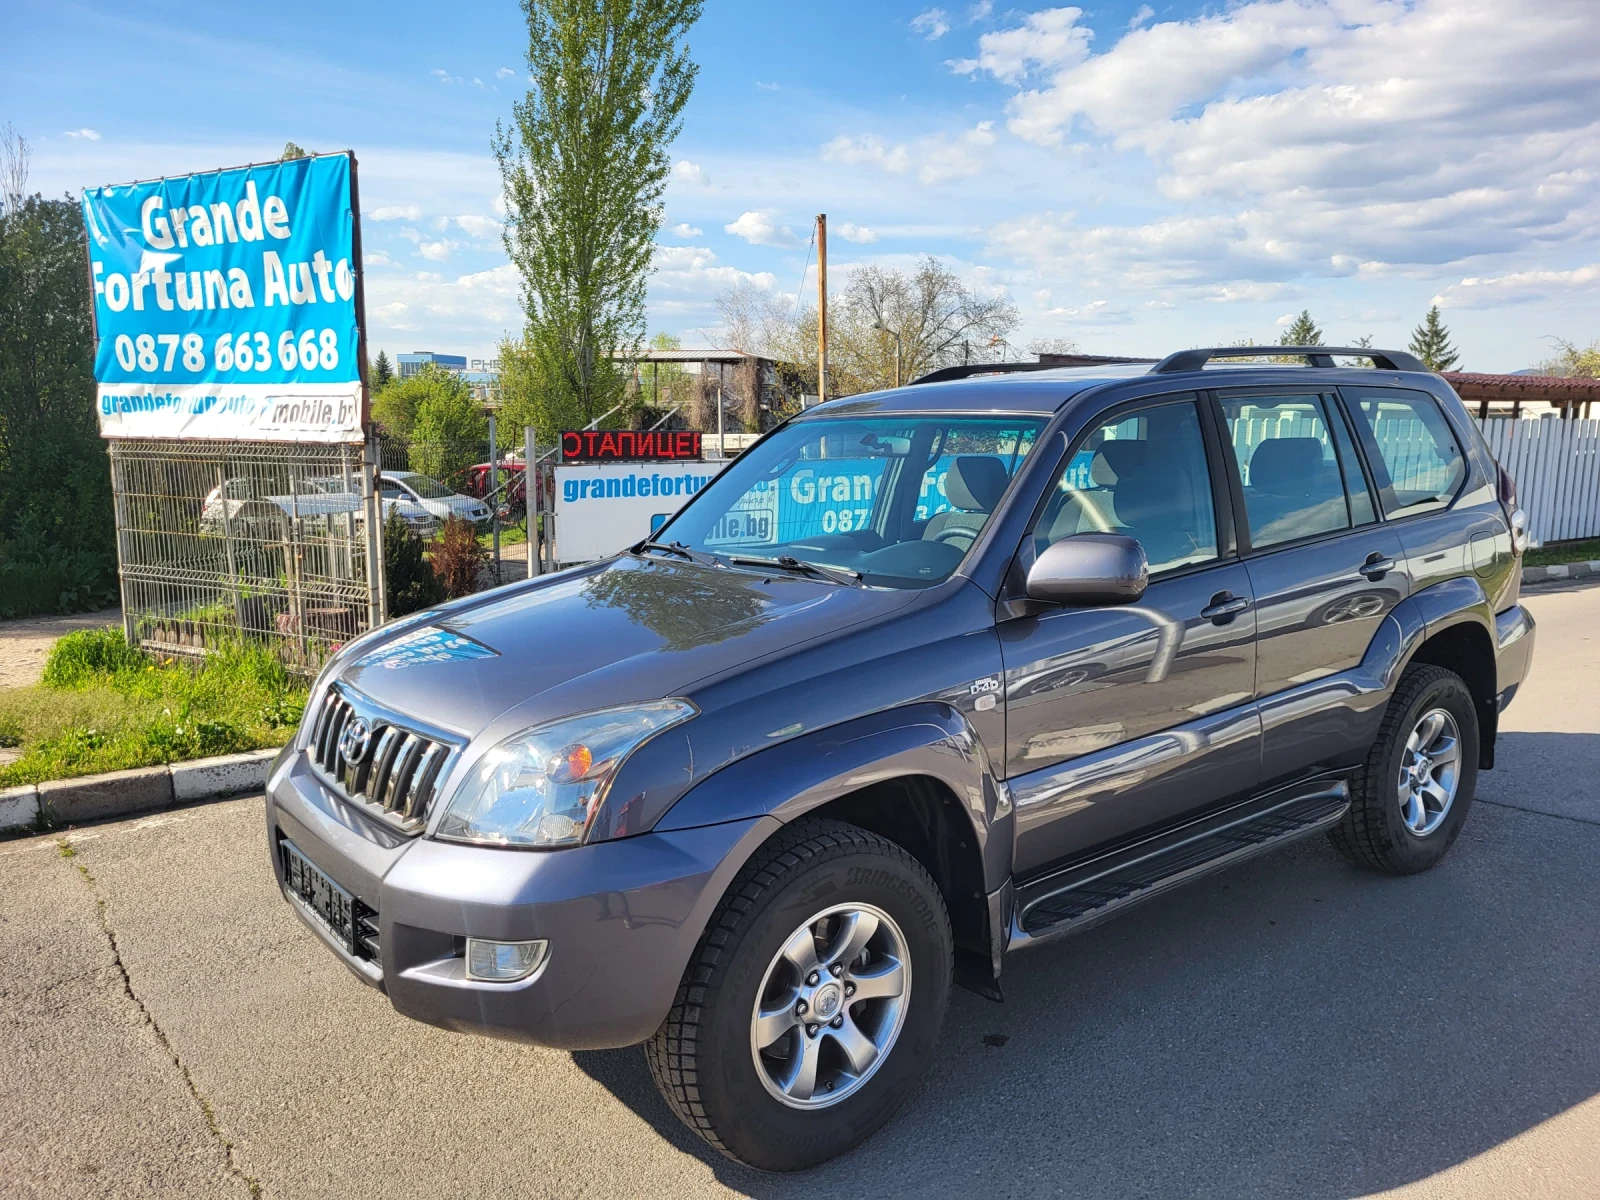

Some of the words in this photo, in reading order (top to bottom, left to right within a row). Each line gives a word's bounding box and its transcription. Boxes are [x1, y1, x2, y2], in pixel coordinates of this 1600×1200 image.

[141, 180, 292, 249] Grande
[263, 250, 354, 307] Auto
[115, 334, 206, 372] 0878
[215, 330, 272, 372] 663
[278, 328, 339, 371] 668
[822, 509, 873, 533] 087
